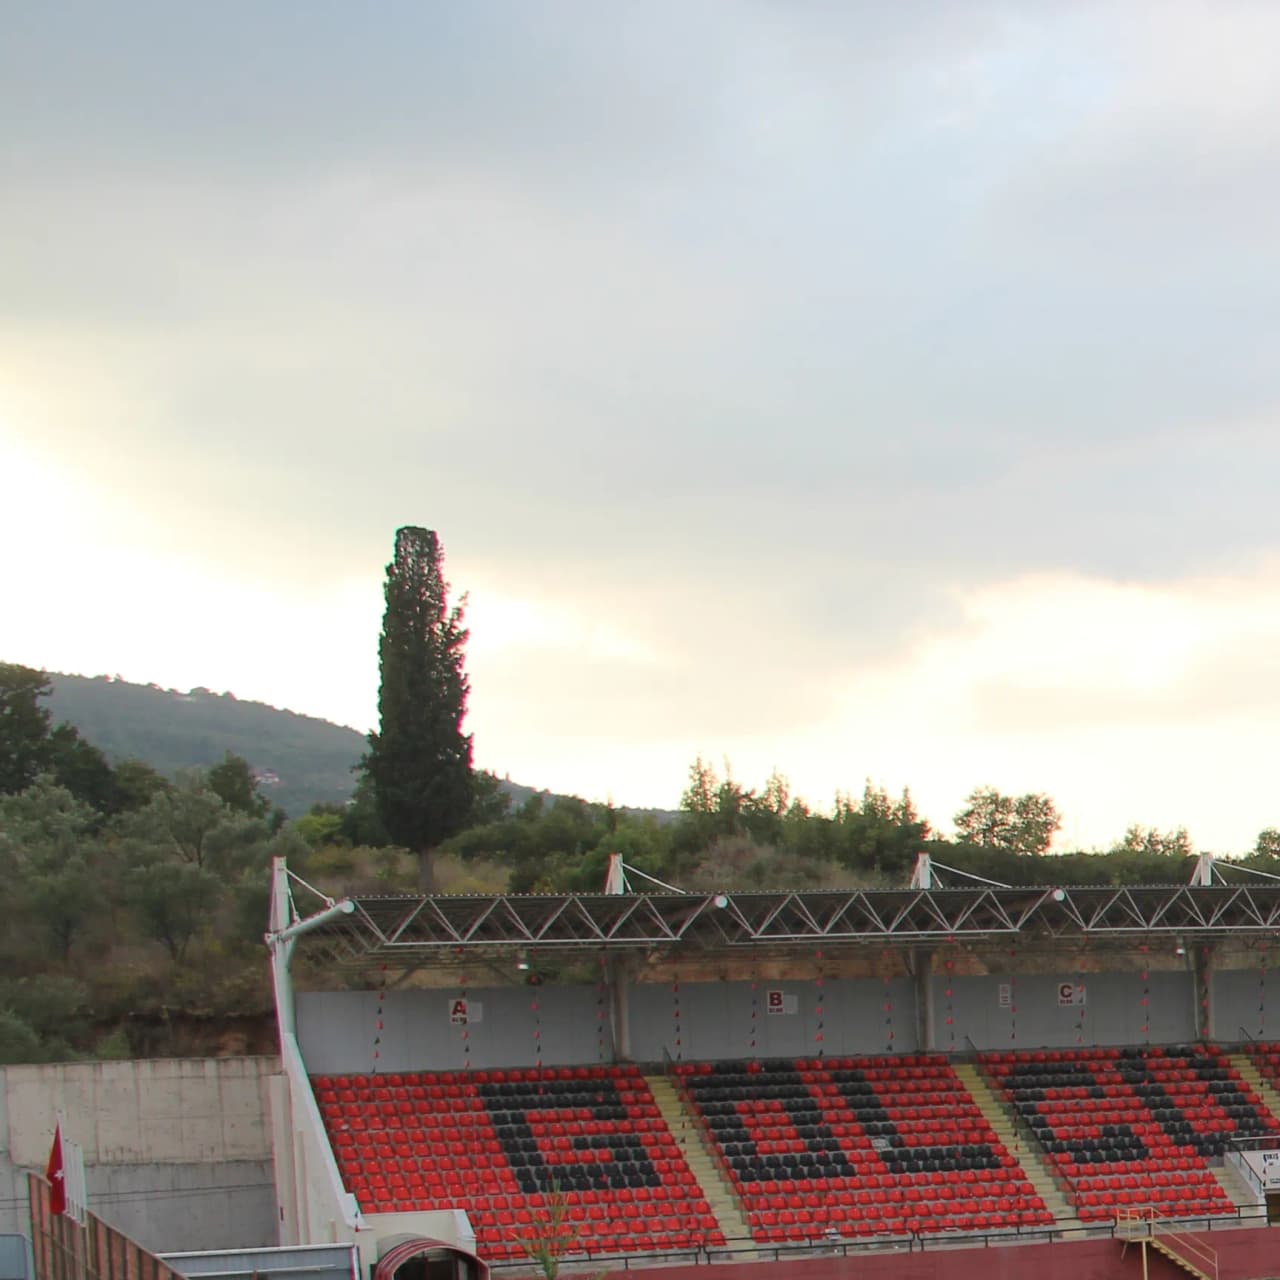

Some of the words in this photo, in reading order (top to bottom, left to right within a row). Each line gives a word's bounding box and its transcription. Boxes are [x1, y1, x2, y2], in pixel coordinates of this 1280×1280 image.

[769, 991, 783, 1006] B
[1060, 984, 1073, 998] C
[452, 1000, 467, 1015] A
